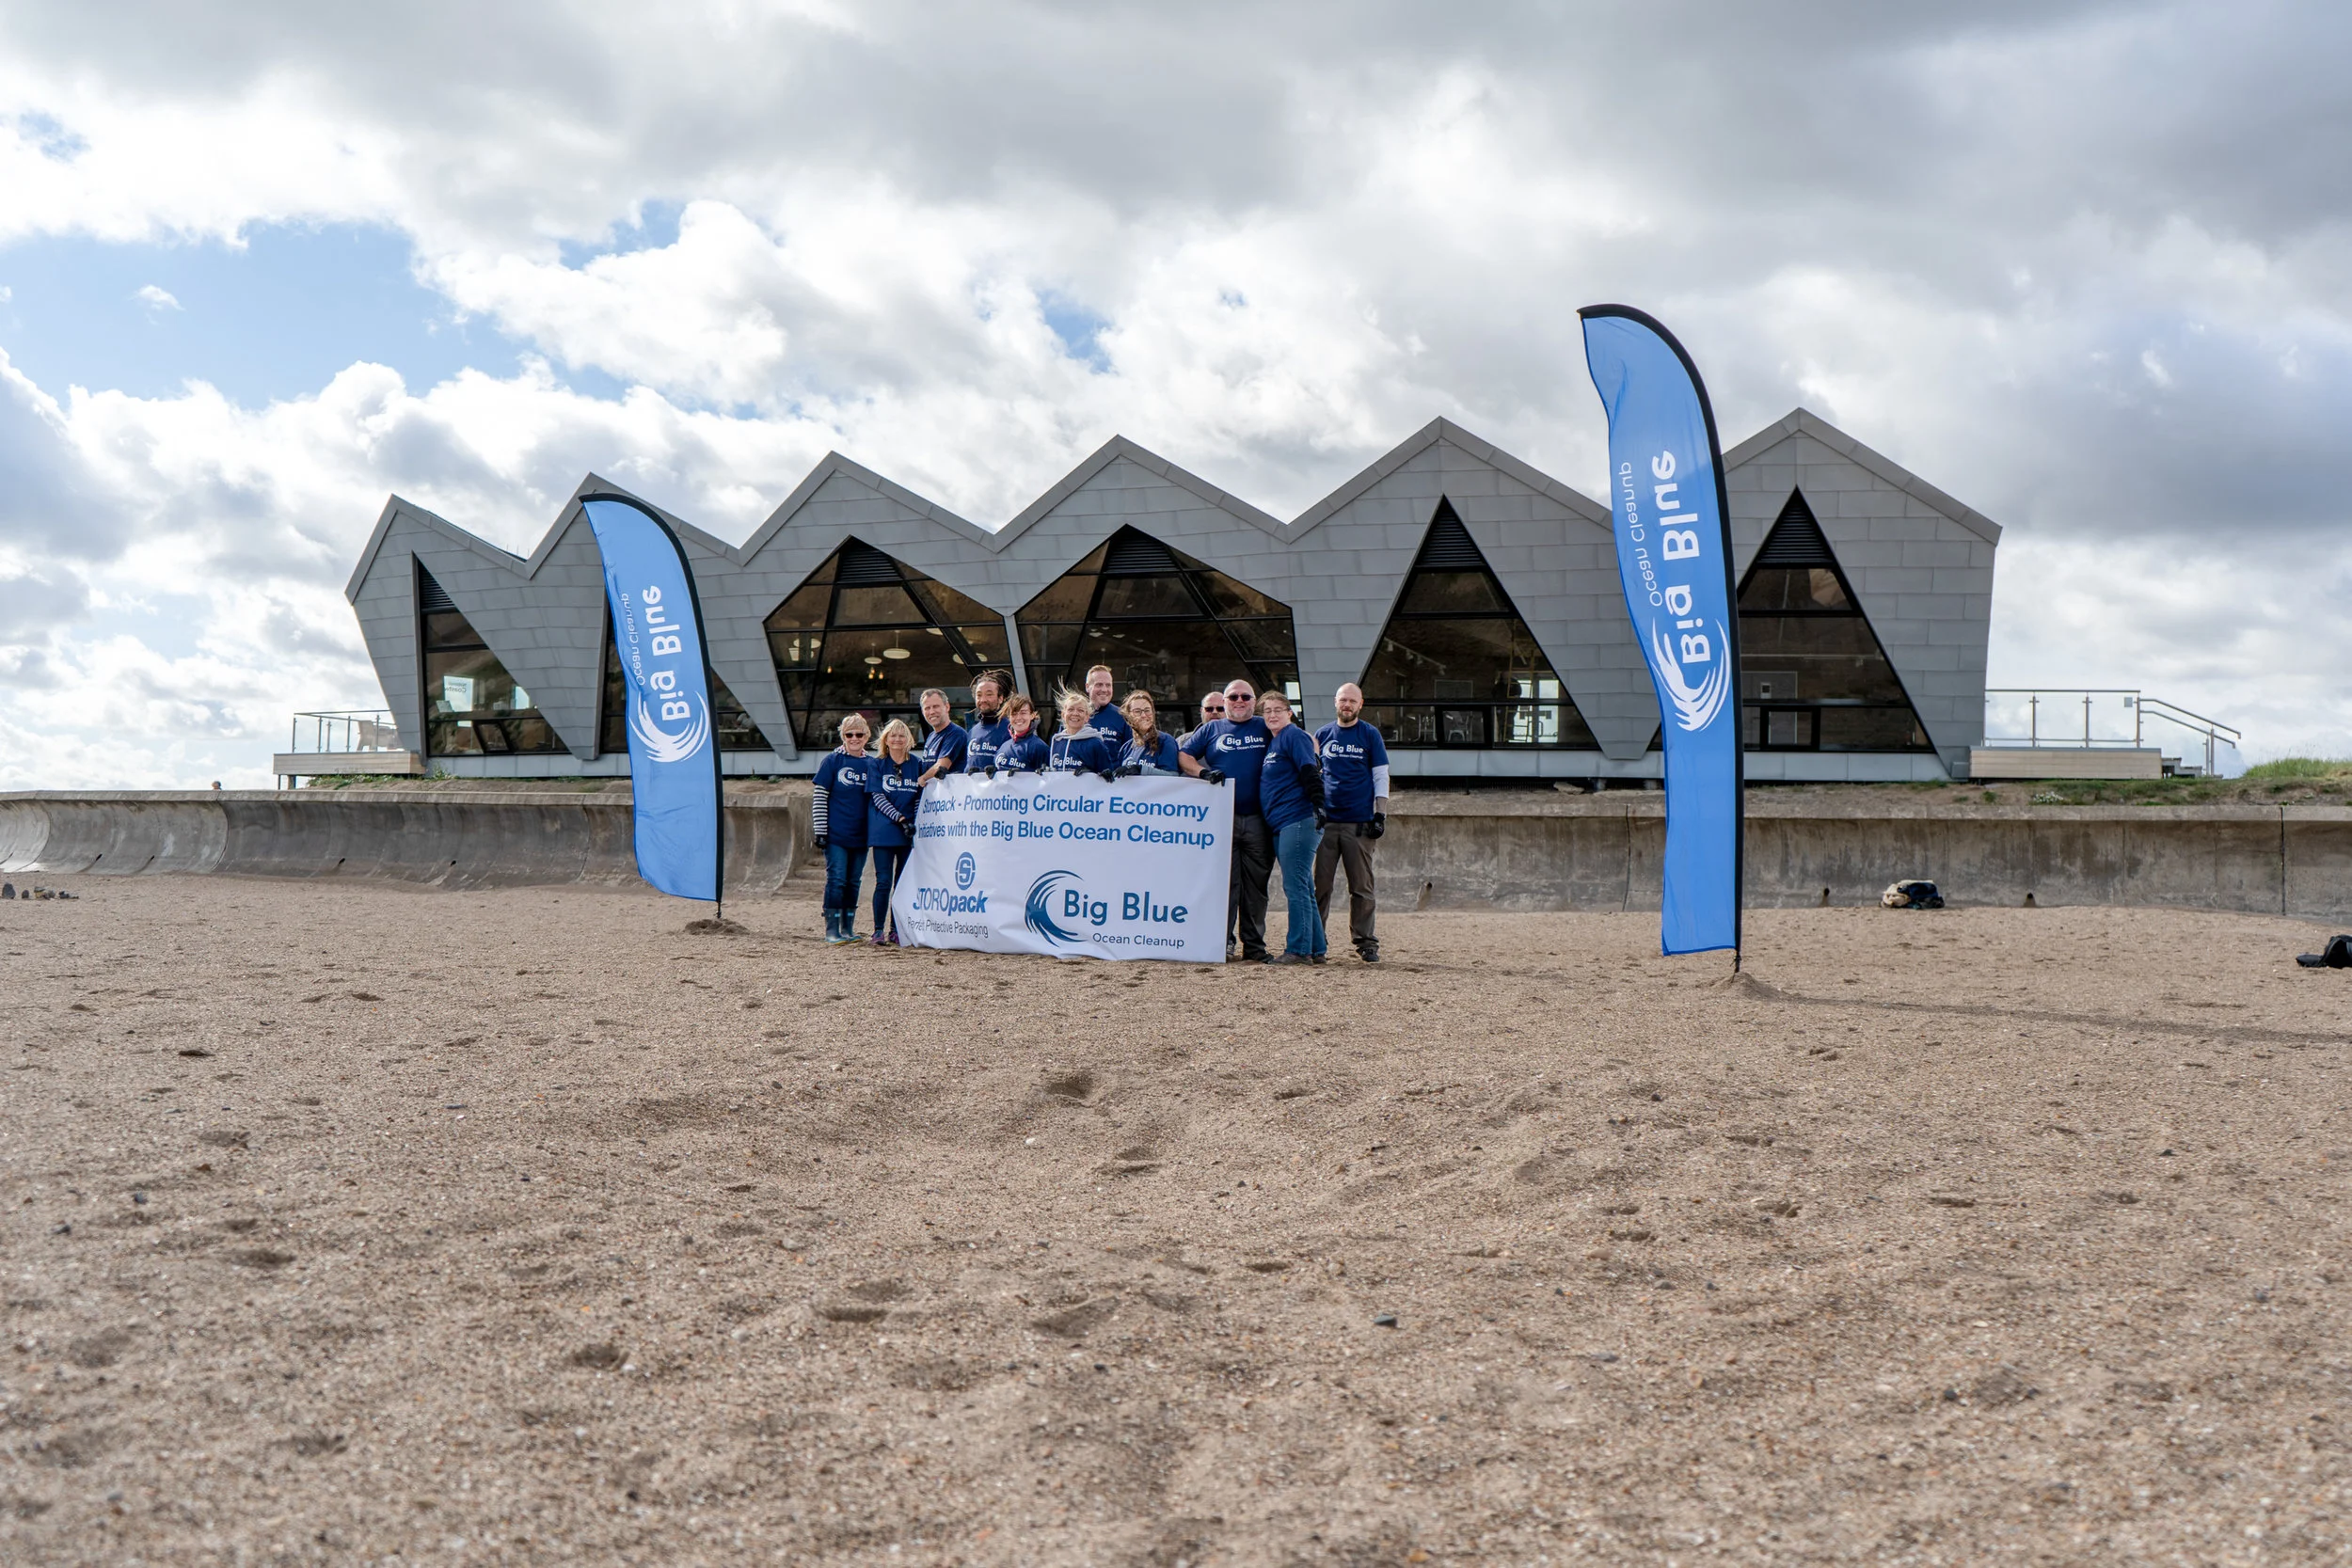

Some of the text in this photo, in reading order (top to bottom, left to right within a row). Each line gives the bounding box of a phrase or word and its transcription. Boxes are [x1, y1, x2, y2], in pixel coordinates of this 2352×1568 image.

[1100, 727, 1117, 736] Blue
[981, 741, 997, 751] Blue
[1226, 736, 1241, 746] Big
[1331, 744, 1363, 752] Big Blue
[1009, 757, 1026, 768] Blue
[847, 771, 860, 781] Big
[889, 778, 901, 787] Big
[963, 794, 1028, 815] Promoting
[1033, 794, 1104, 813] Circular
[1109, 797, 1209, 822] Economy
[947, 820, 967, 837] with
[970, 820, 988, 837] the
[991, 820, 1013, 841] Big
[1018, 821, 1054, 838] Blue
[1058, 822, 1120, 841] Ocean
[1127, 824, 1215, 849] Cleanup
[1063, 889, 1188, 926] Big Blue
[954, 921, 989, 938] Packaging
[1092, 932, 1184, 949] Ocean Cleanup
